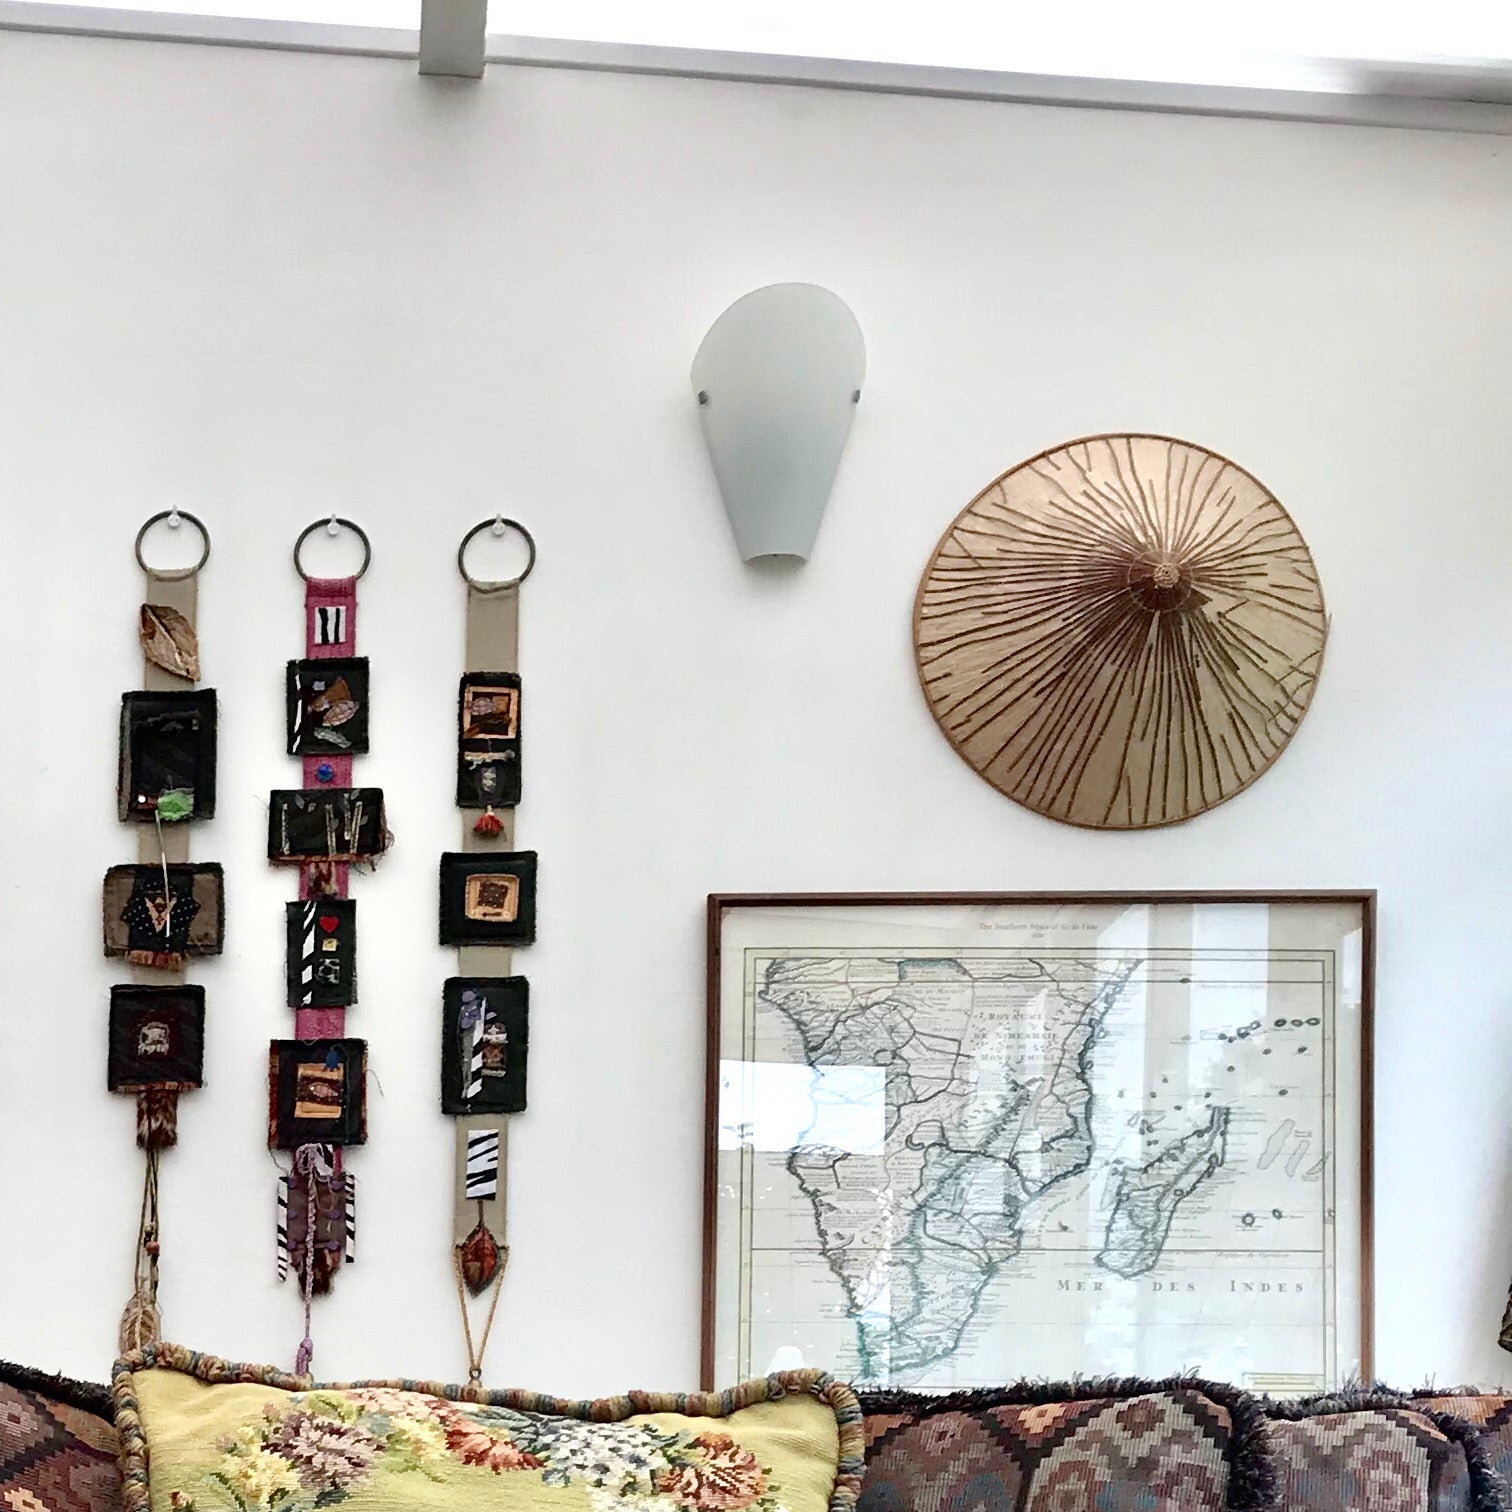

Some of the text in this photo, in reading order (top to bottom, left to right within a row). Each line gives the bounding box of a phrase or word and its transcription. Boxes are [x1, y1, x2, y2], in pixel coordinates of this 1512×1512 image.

[1056, 1279, 1304, 1293] MER DES INDES
